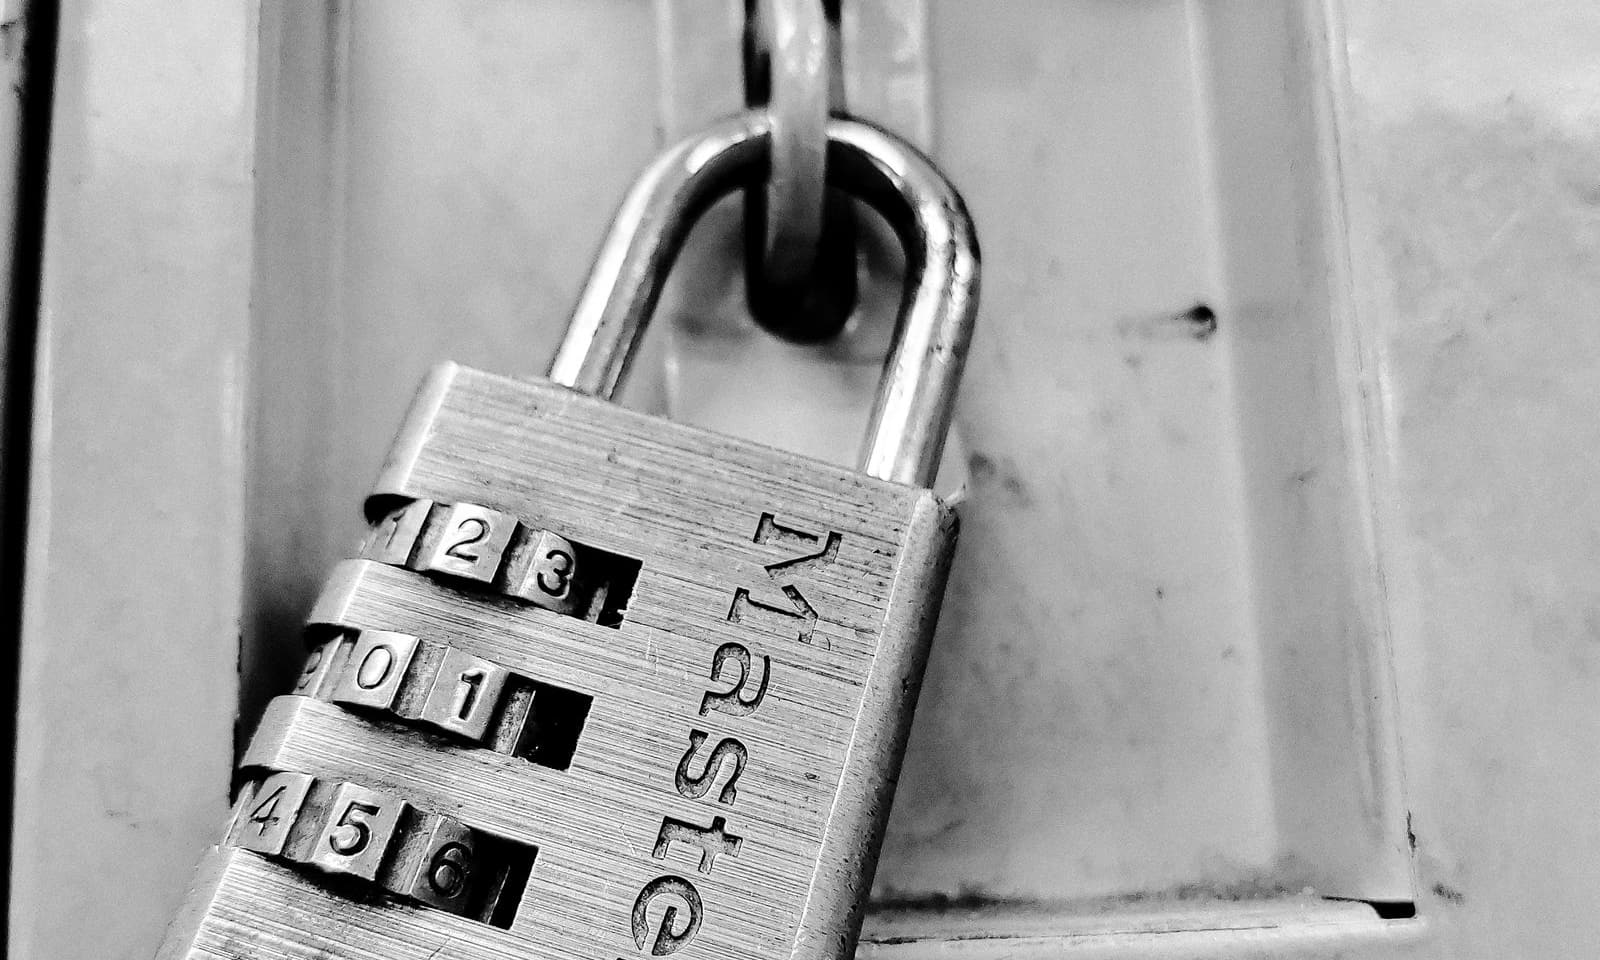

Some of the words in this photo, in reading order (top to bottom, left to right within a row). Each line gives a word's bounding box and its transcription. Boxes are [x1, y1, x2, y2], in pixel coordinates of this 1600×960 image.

[446, 518, 491, 562] 2
[536, 549, 575, 597] 3
[356, 644, 393, 690] 0
[455, 671, 485, 721] 1
[616, 512, 842, 960] Maste
[250, 785, 287, 836] 4
[329, 801, 381, 856] 5
[427, 841, 474, 898] 6
